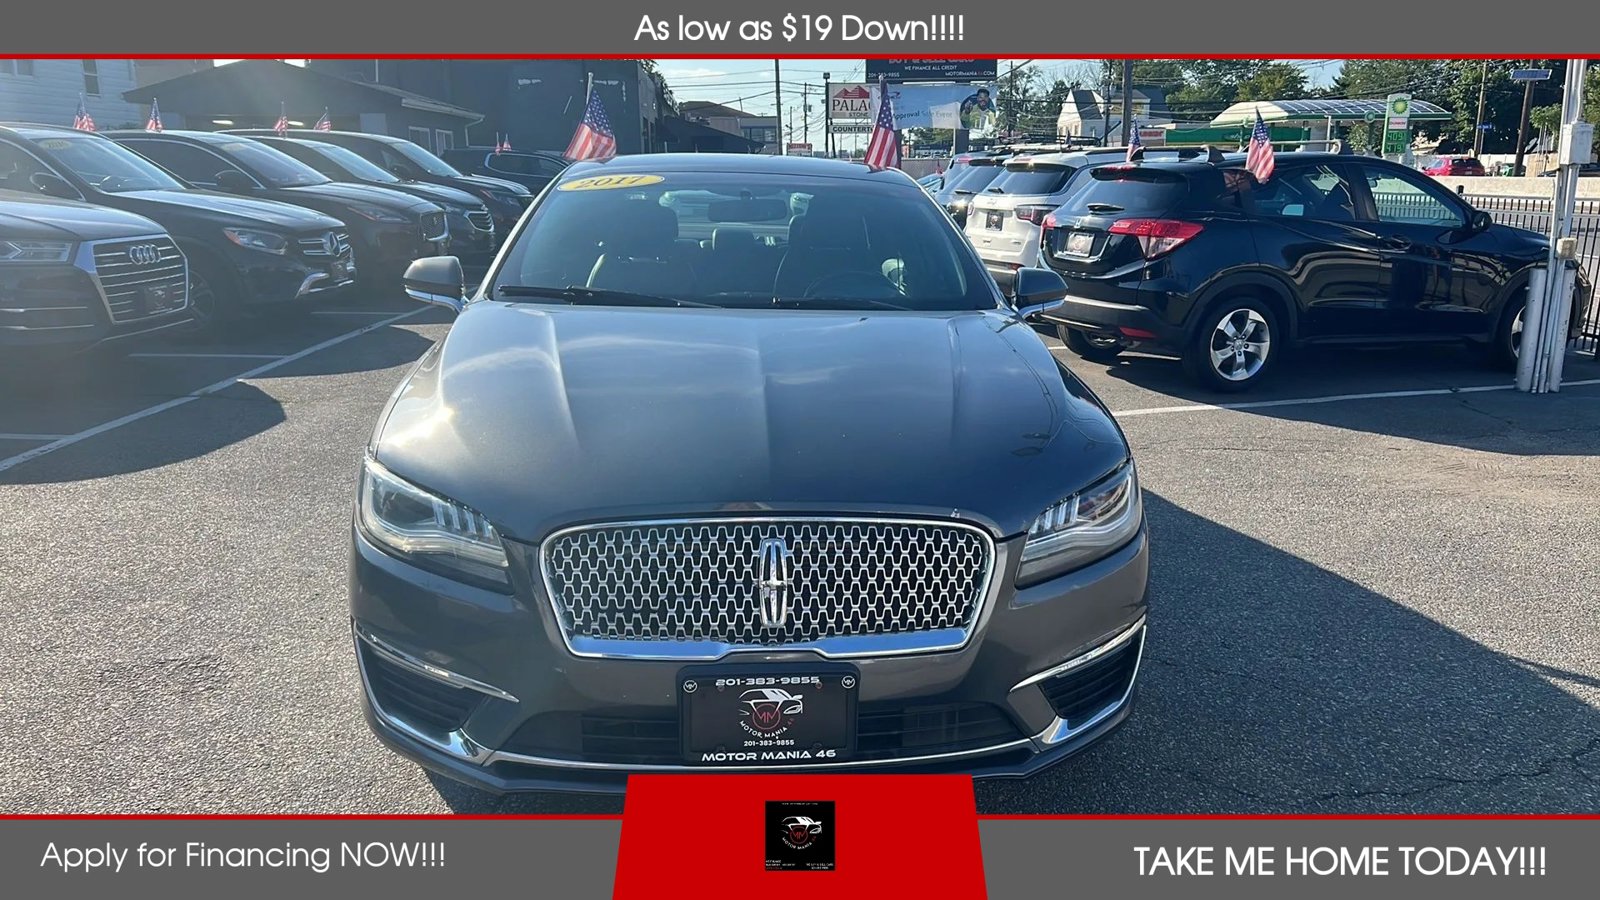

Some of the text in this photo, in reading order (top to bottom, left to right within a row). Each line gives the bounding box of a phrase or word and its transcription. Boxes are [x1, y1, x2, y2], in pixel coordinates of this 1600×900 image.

[575, 175, 646, 189] 2017
[715, 676, 820, 687] 201-383-9855
[740, 720, 763, 739] MOTOR
[764, 726, 788, 738] MANIA
[743, 739, 795, 747] 201-383-9855
[701, 749, 837, 762] MOTOR MANIA 46
